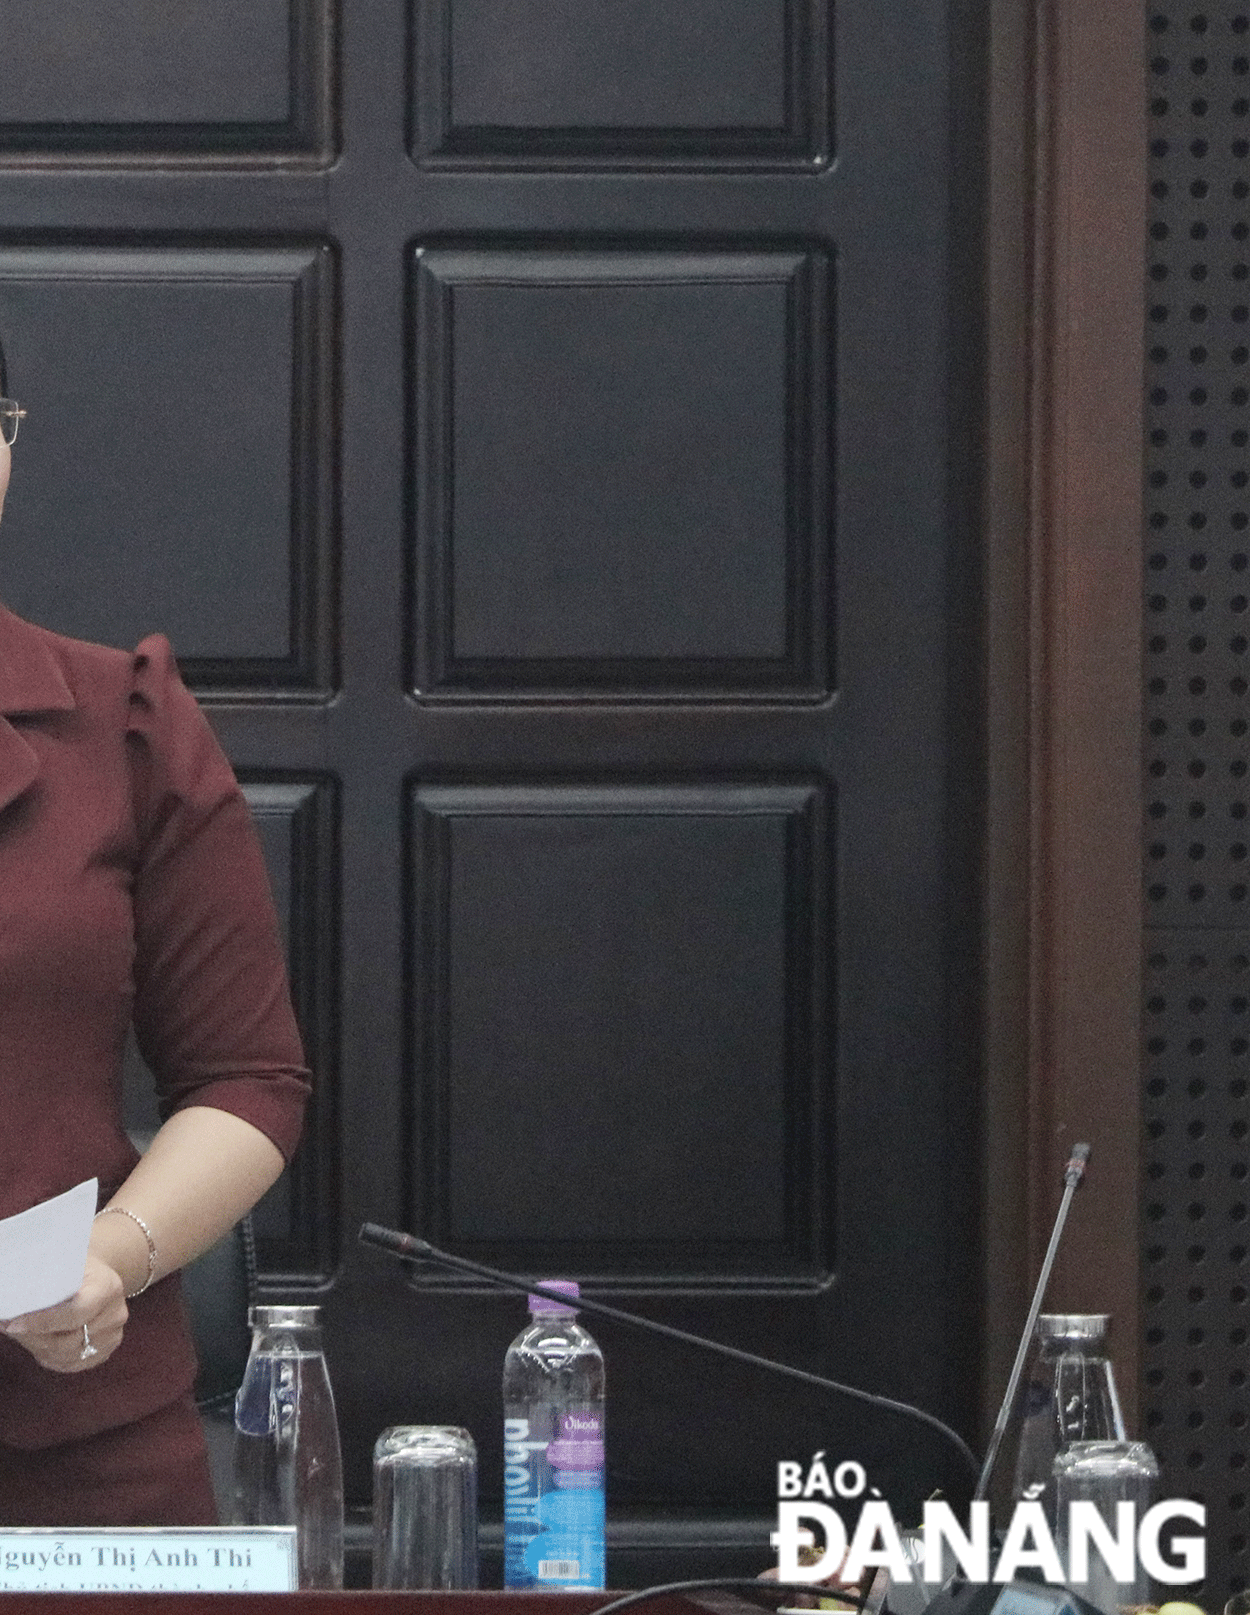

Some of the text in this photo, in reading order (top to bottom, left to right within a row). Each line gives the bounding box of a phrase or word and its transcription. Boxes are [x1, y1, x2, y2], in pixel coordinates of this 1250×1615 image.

[91, 1547, 136, 1572] Thị
[144, 1547, 198, 1566] Anh
[207, 1547, 252, 1567] Thi
